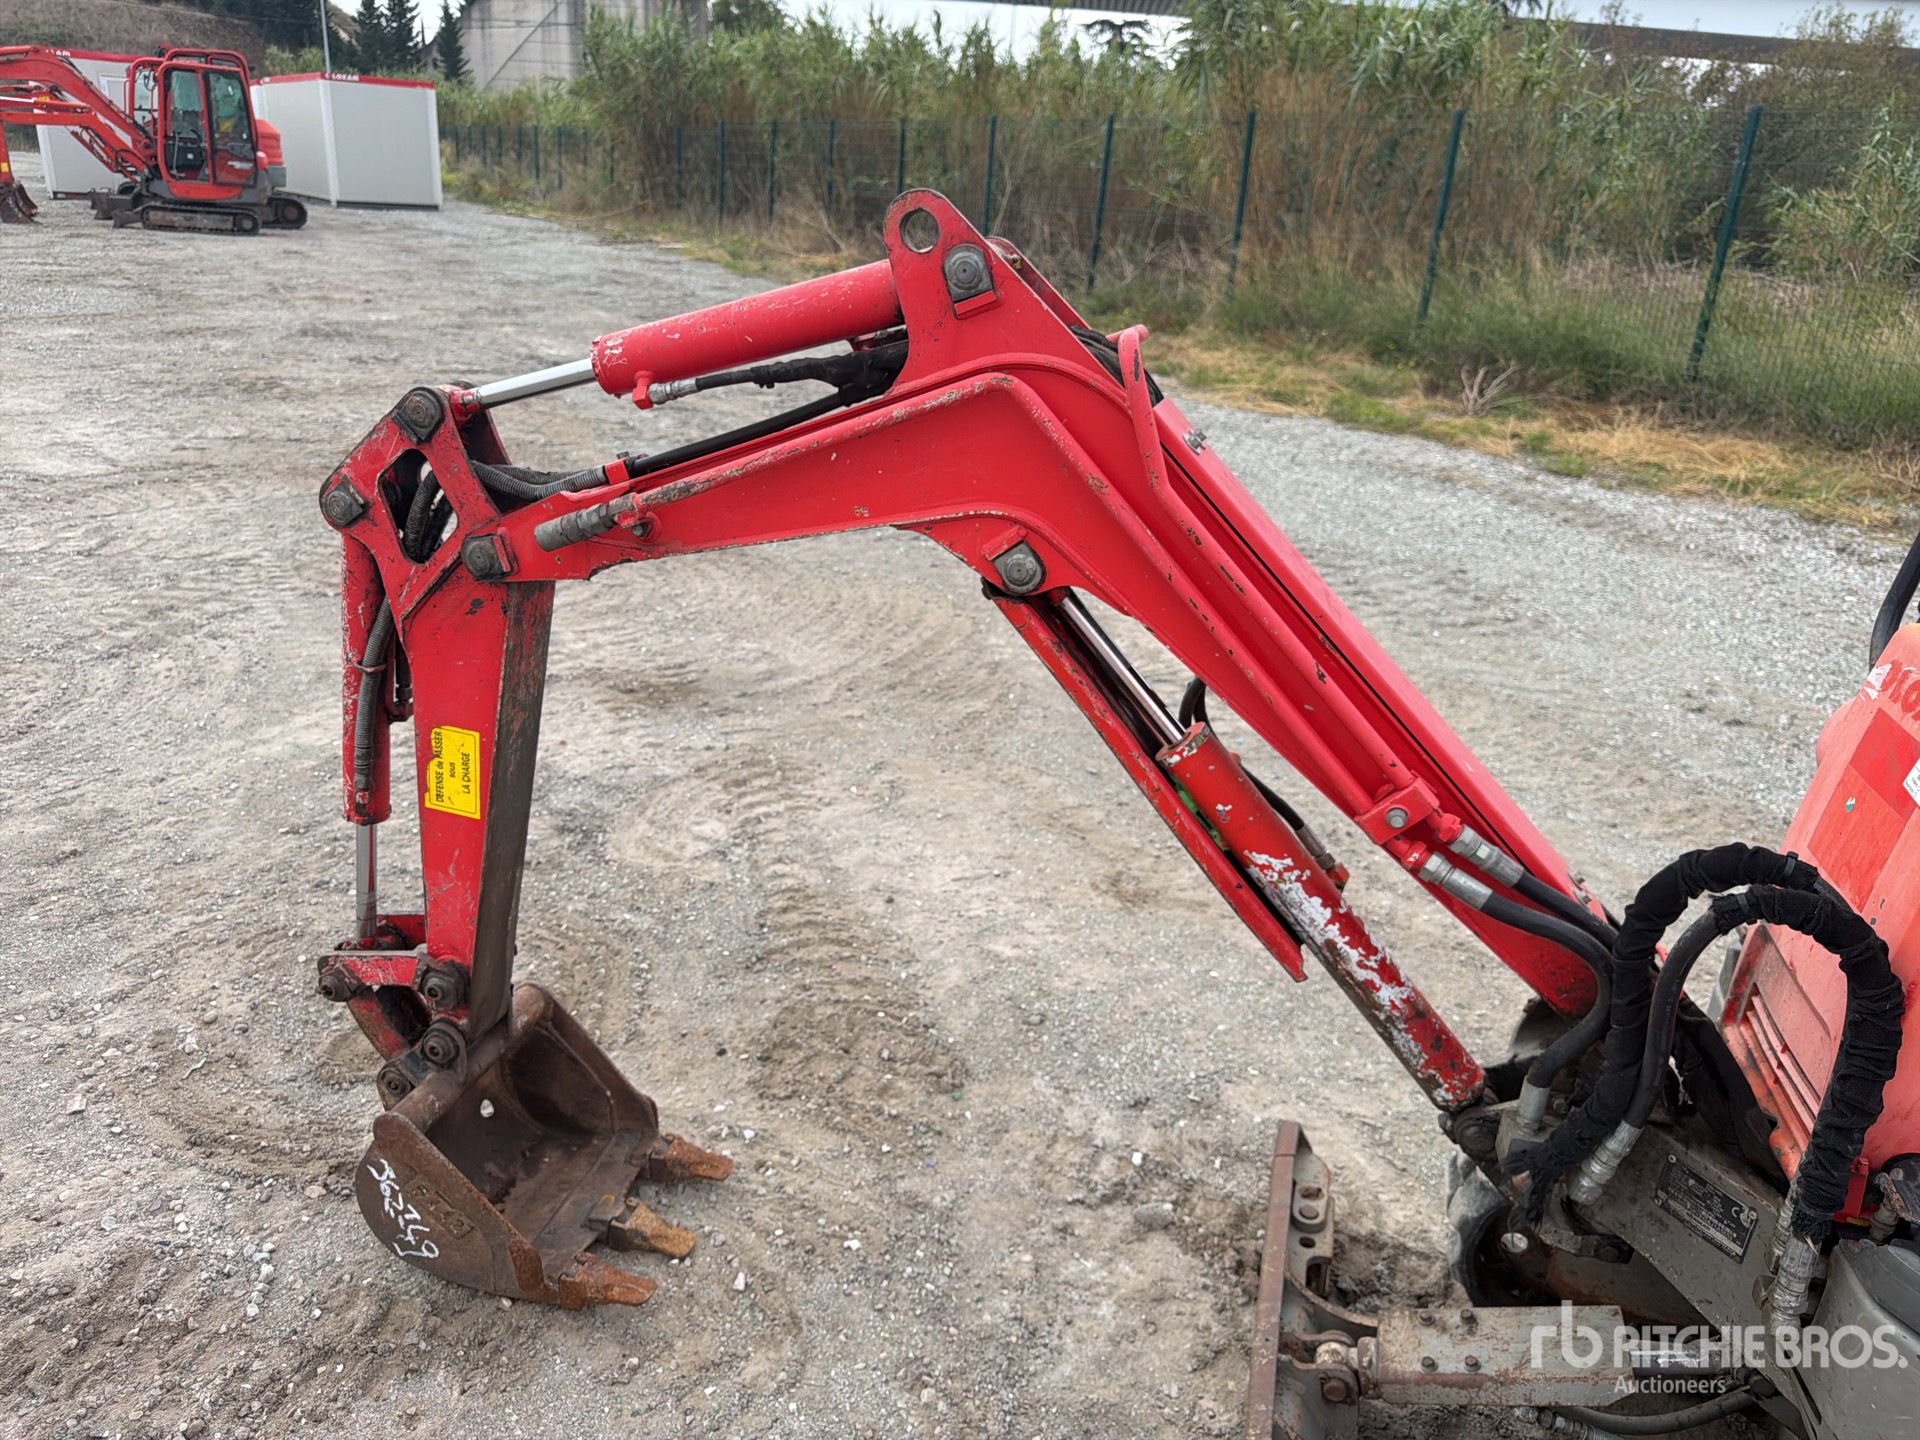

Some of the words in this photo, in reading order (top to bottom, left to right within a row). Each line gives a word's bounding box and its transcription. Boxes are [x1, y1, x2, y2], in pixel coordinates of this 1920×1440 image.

[435, 730, 443, 758] PASSER
[436, 761, 444, 770] de
[461, 752, 471, 782] CHARGE
[435, 771, 444, 803] DEFENSE
[462, 785, 471, 794] LA
